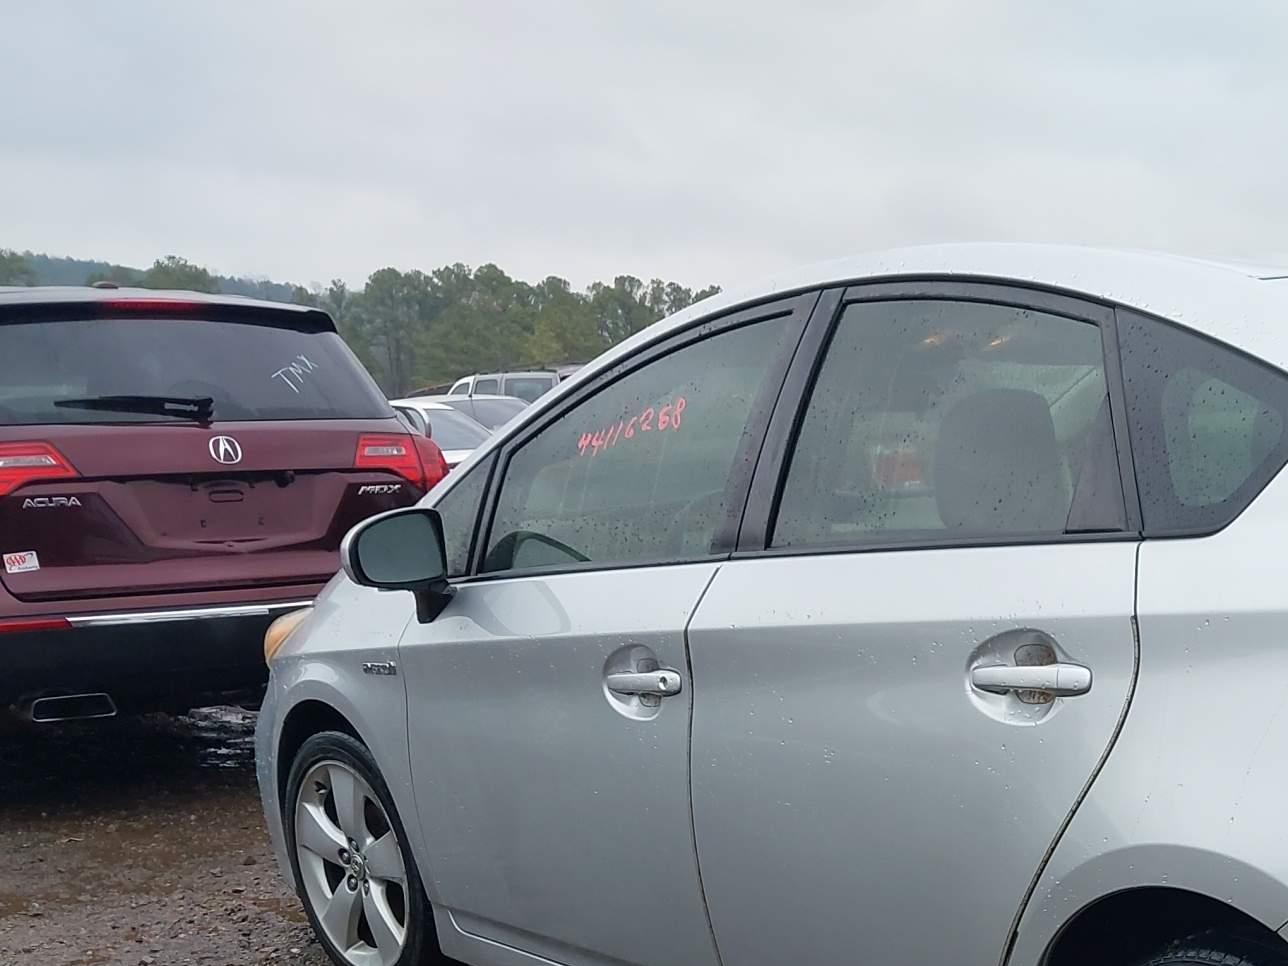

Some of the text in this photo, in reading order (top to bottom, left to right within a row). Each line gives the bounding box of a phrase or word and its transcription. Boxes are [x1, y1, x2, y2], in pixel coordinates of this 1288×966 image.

[577, 397, 687, 457] 44116268
[357, 484, 402, 495] MDX
[22, 496, 83, 509] ACURA
